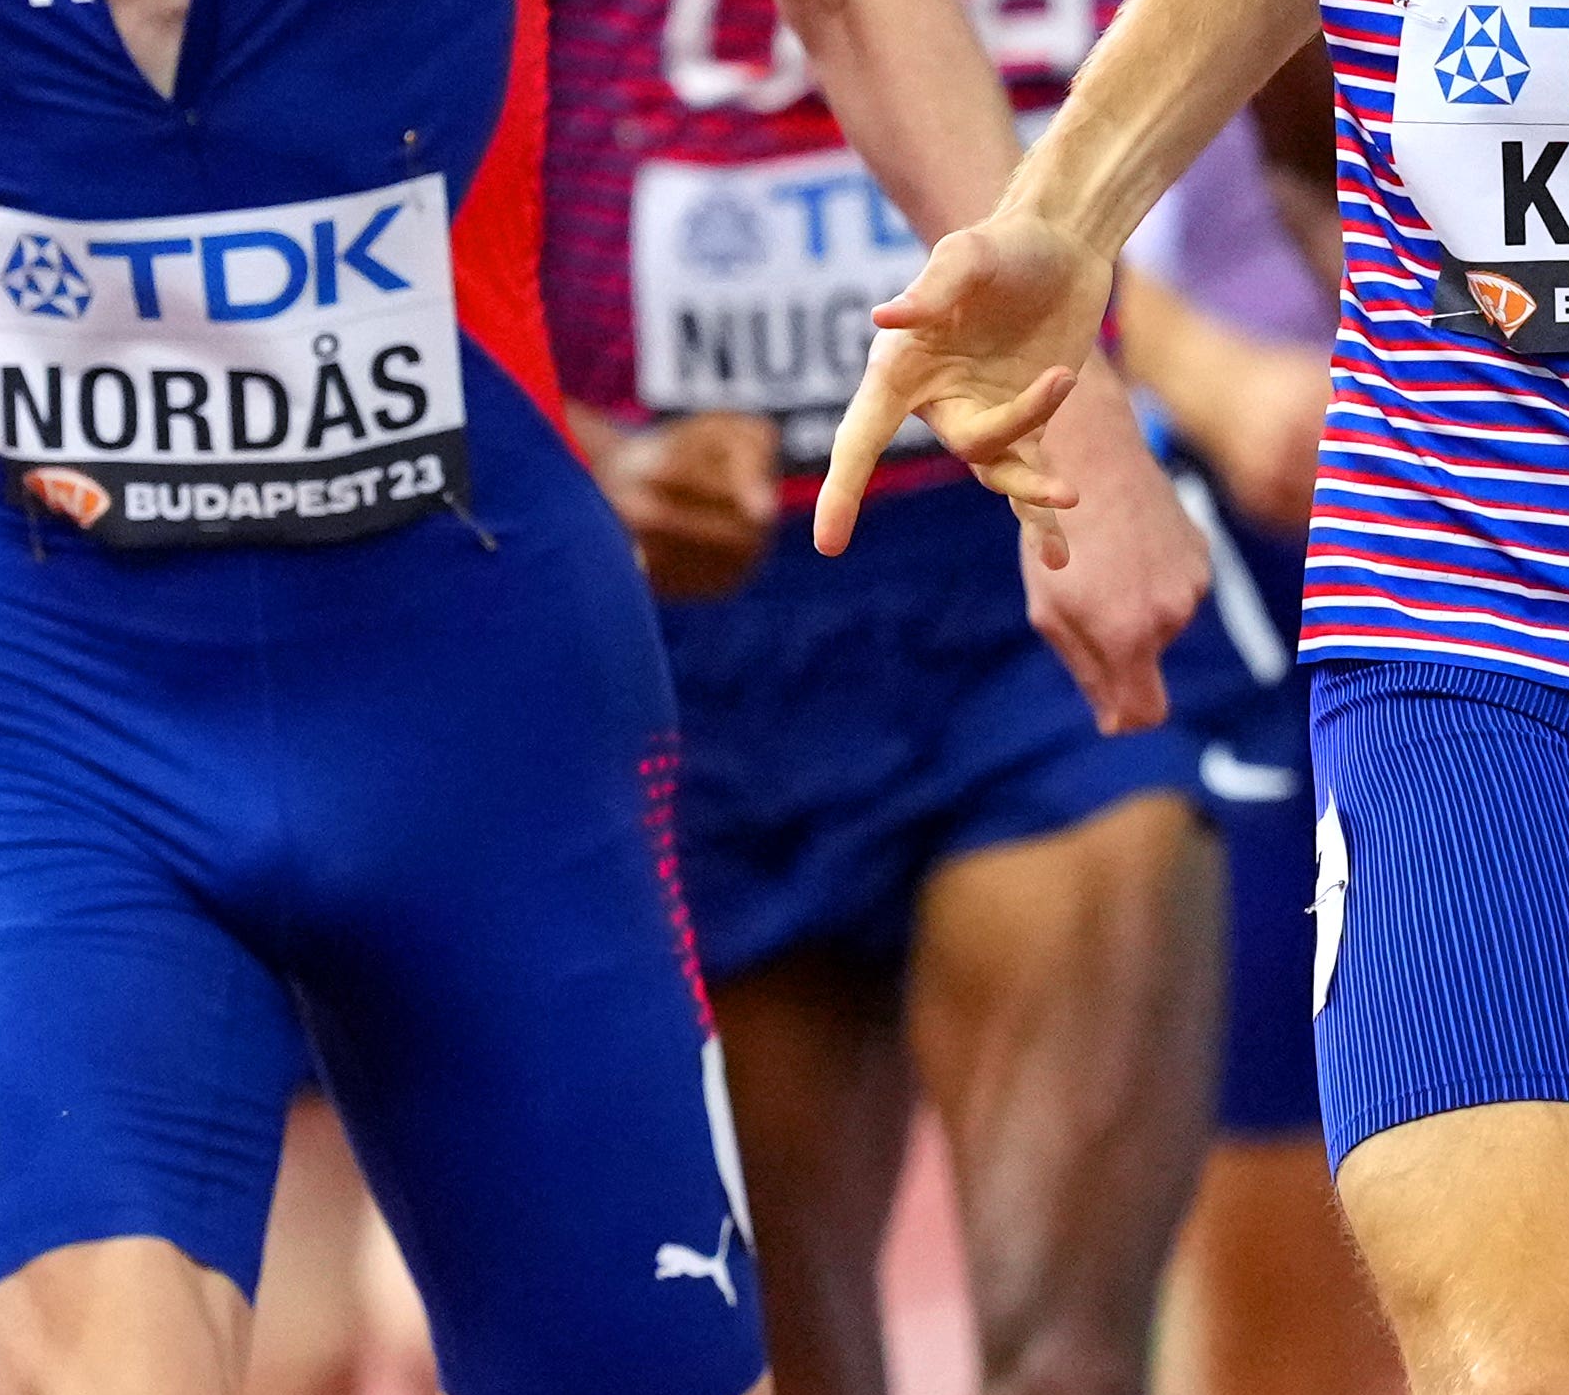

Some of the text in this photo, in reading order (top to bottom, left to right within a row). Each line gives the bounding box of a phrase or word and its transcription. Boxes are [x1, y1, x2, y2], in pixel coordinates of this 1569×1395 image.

[87, 204, 413, 323] TDK
[0, 332, 429, 452] NORDÅS
[124, 454, 446, 521] BUDAPEST 23
